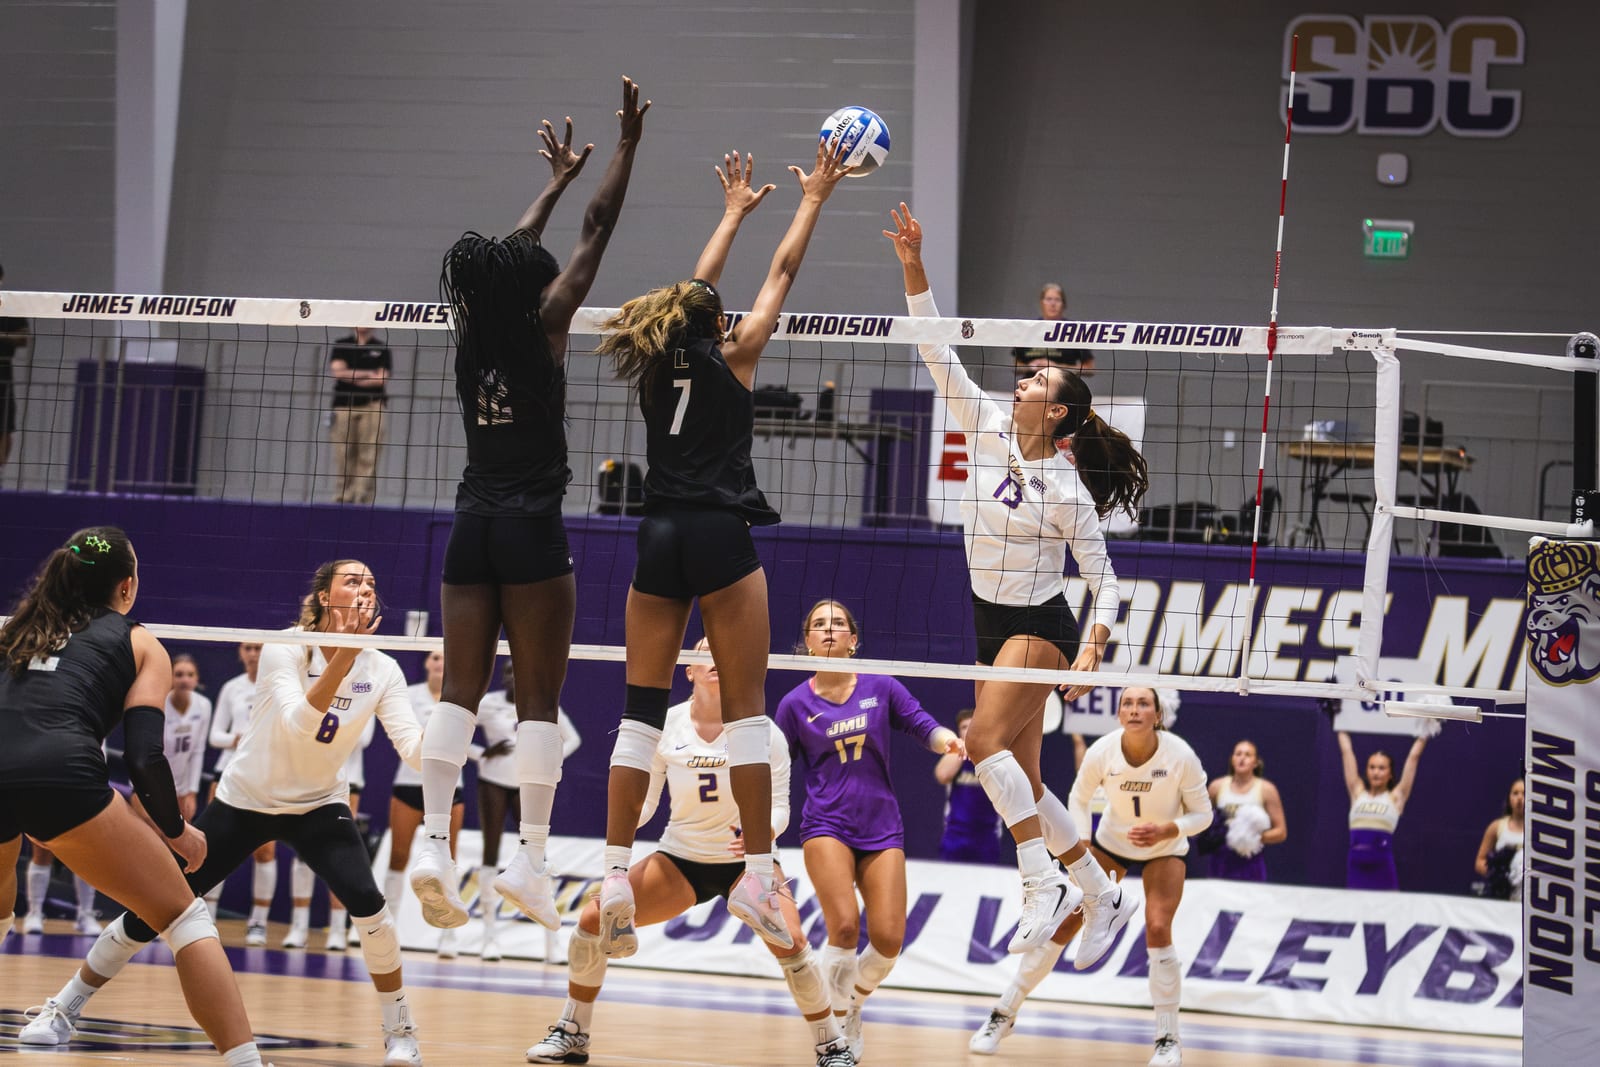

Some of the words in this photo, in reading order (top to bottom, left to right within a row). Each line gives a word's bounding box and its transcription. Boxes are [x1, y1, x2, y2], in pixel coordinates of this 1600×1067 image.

[1281, 14, 1525, 137] SBC
[62, 294, 135, 314] JAMES
[138, 296, 236, 317] MADISON
[375, 303, 451, 324] JAMES
[786, 315, 894, 337] MADISON
[1044, 322, 1127, 343] JAMES
[1131, 325, 1244, 347] MADISON
[669, 379, 692, 435] 7
[315, 711, 340, 744] 8
[826, 713, 868, 738] JMU
[686, 755, 727, 769] JMU
[834, 734, 867, 765] 17
[698, 772, 720, 804] 2
[1120, 780, 1153, 793] JMU
[1131, 796, 1142, 818] 1
[1528, 730, 1576, 996] MADISON
